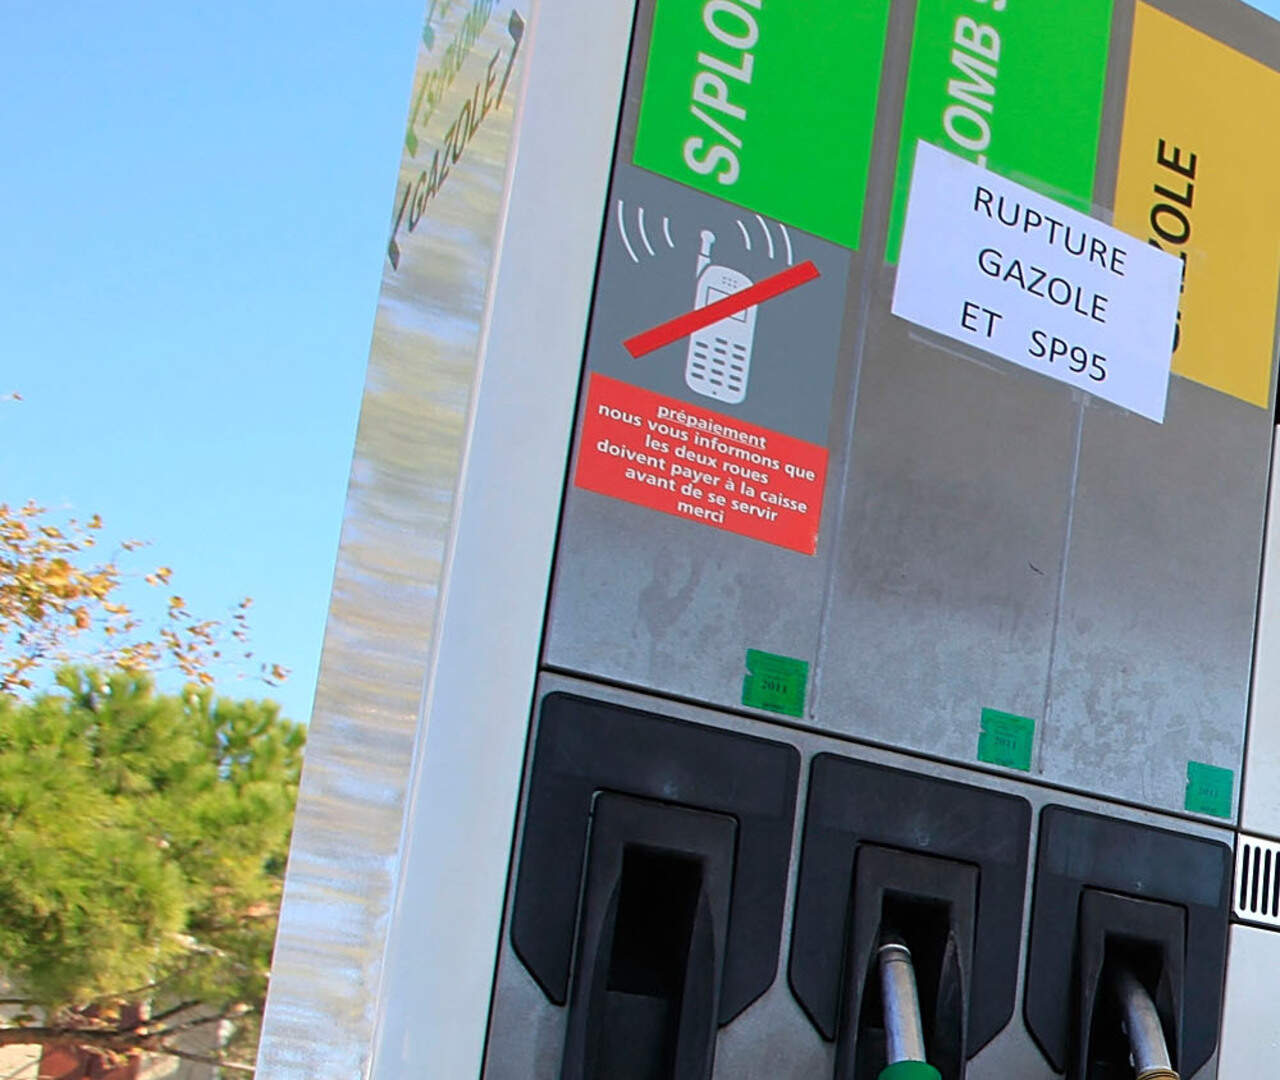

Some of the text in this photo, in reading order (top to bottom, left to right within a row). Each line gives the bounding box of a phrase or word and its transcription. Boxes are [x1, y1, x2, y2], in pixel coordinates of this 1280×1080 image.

[683, 0, 764, 186] S/PLO
[943, 16, 1001, 168] OMB
[973, 186, 1128, 276] RUPTURE
[1149, 138, 1197, 354] OLE
[978, 248, 1109, 323] GAZOLE
[961, 301, 1107, 382] ET SP95
[598, 404, 816, 481] nous vous informons que
[645, 434, 769, 484] les deux roues
[656, 405, 767, 450] prépaiement
[596, 439, 808, 513] doivent payer à la caisse
[625, 466, 778, 522] avant de se servir
[677, 499, 725, 523] merci
